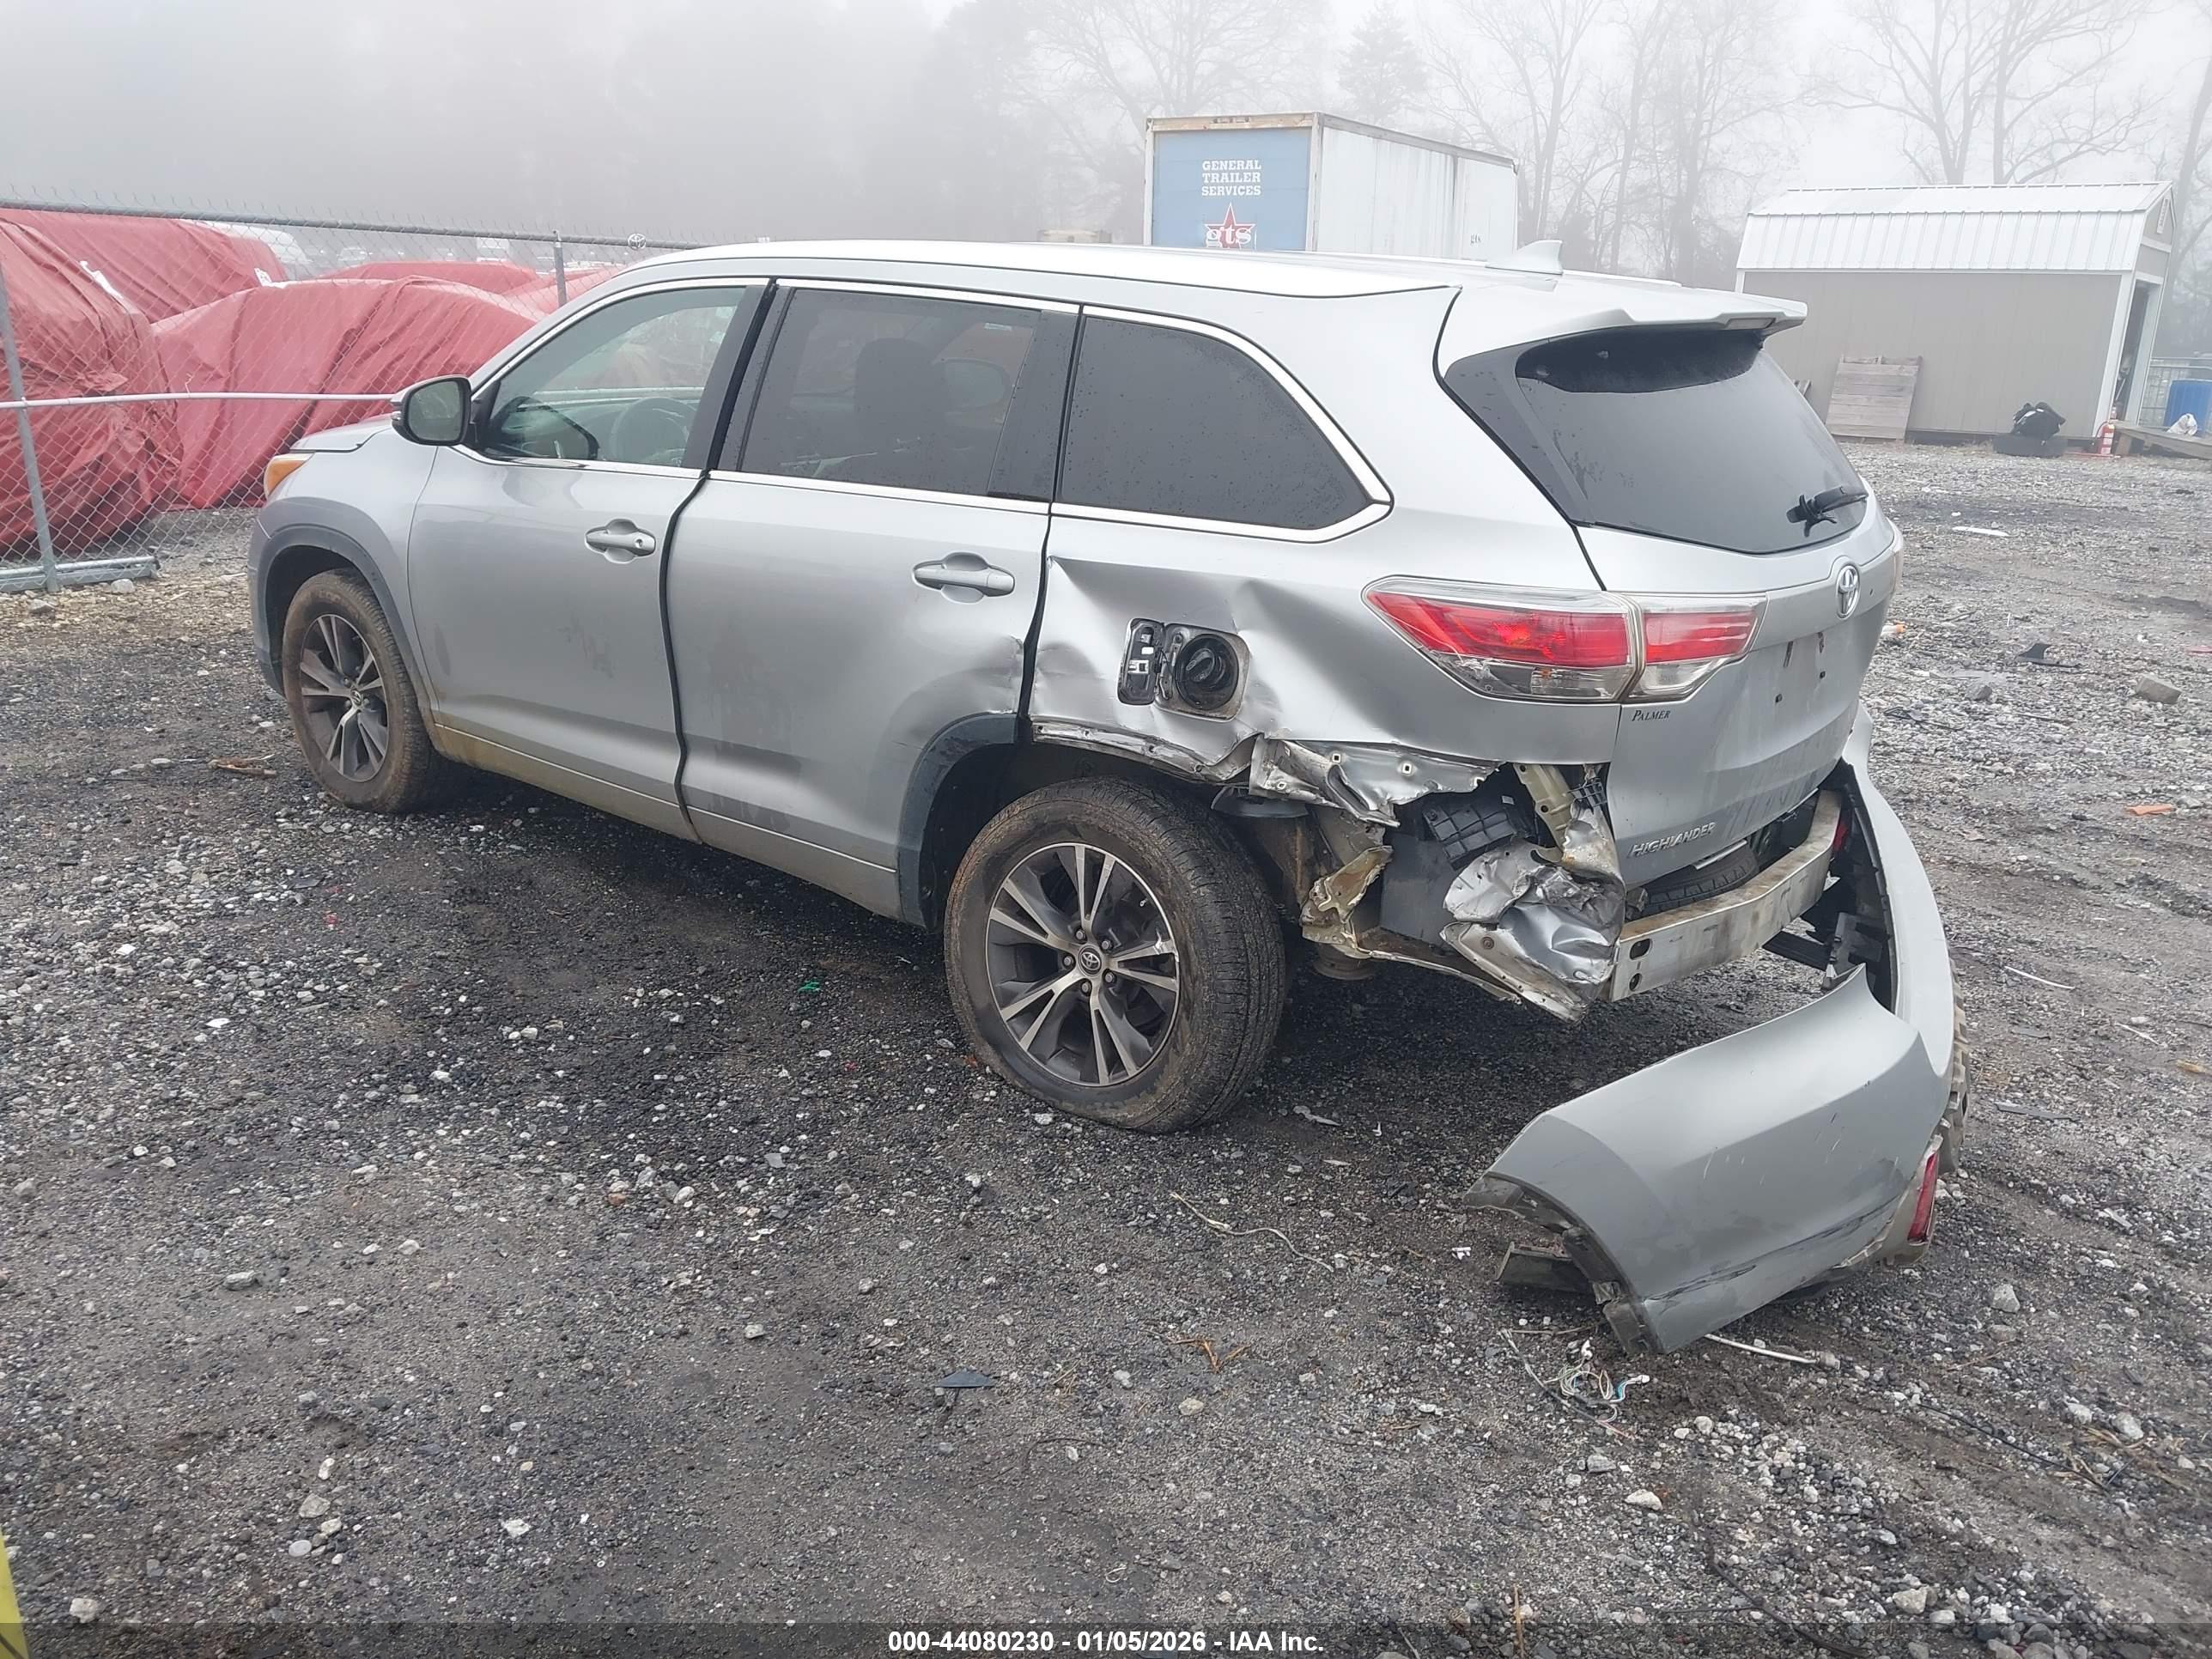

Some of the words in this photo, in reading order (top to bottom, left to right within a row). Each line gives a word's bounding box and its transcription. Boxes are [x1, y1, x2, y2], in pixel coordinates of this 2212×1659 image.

[1201, 160, 1262, 171] GENERAL
[1201, 172, 1261, 184] TRAILER
[1201, 185, 1261, 197] SERVICES
[1632, 709, 1671, 722] PALMER
[1628, 822, 1717, 857] HIGHLANDER
